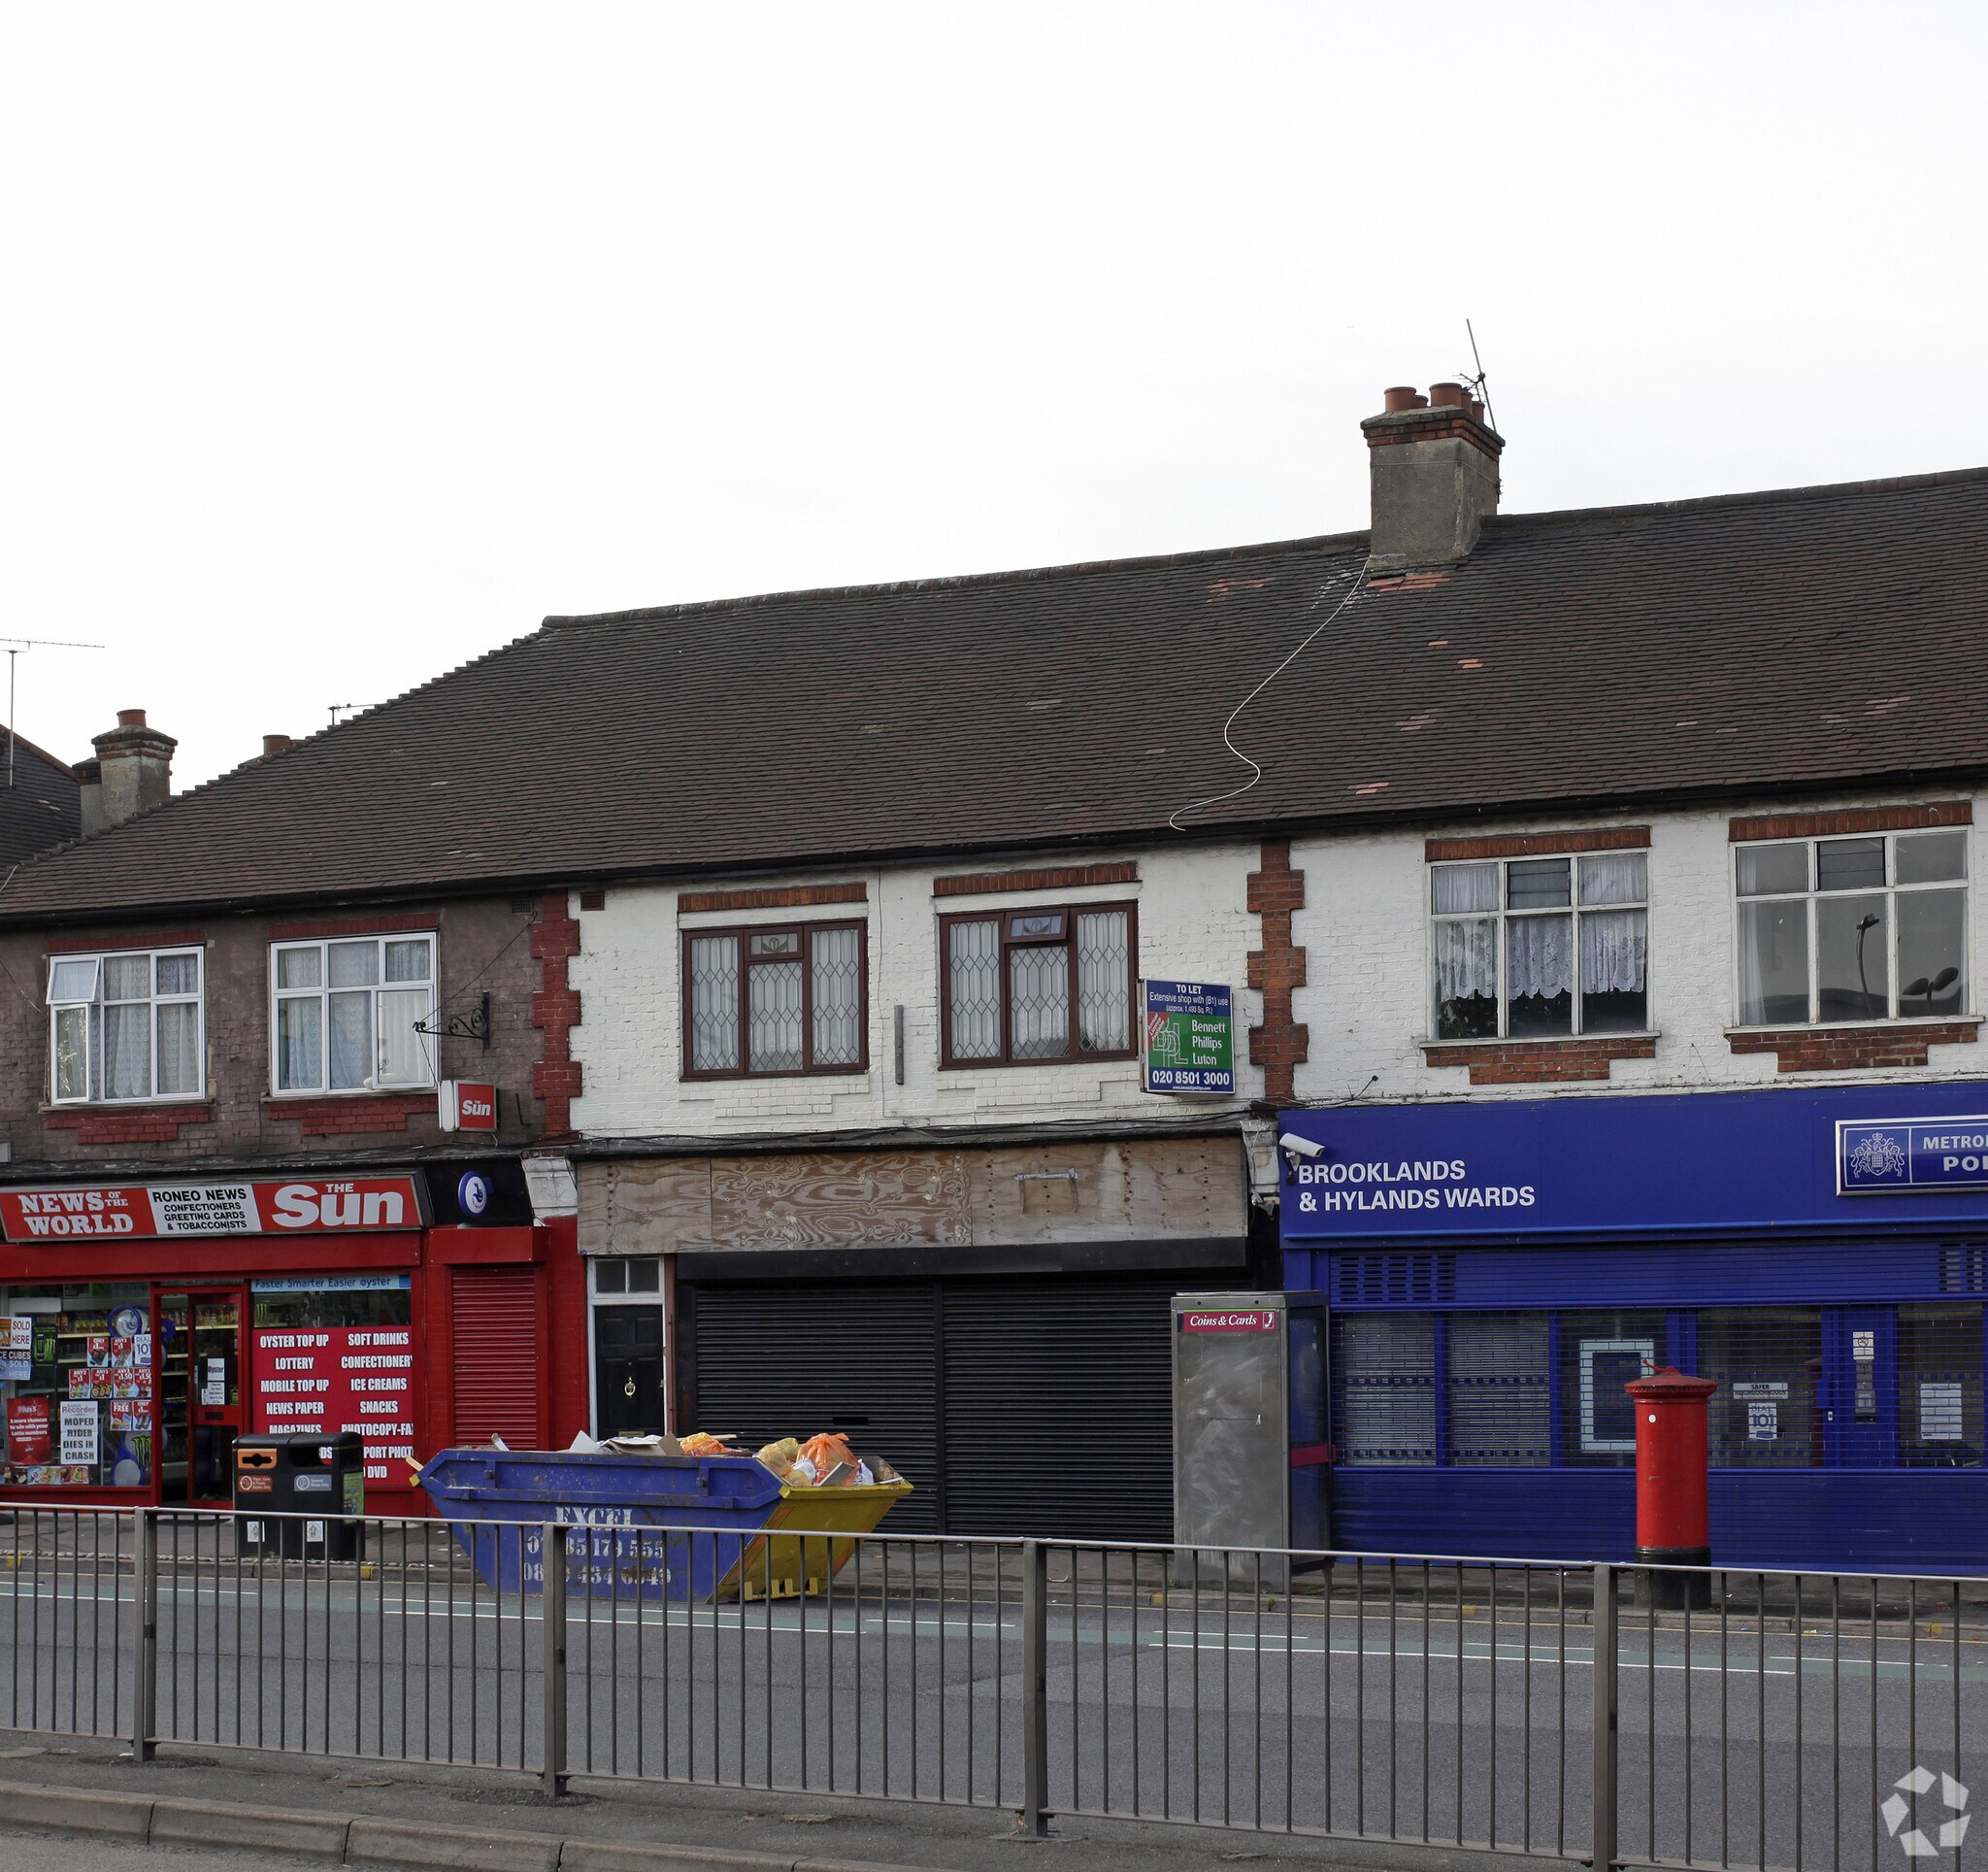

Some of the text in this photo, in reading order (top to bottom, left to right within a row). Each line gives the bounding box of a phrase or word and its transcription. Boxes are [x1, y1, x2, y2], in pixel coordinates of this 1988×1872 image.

[1176, 985, 1202, 994] TO LET
[1149, 992, 1176, 1003] Extensive
[1177, 993, 1192, 1005] shop
[1193, 995, 1204, 1004] with
[1192, 1020, 1226, 1033] Bennett
[1192, 1035, 1222, 1052] Phillips
[1193, 1053, 1216, 1065] Luton
[1152, 1070, 1230, 1086] 020 8501 3000
[462, 1099, 491, 1116] Sun
[1923, 1134, 1988, 1150] METRO
[1298, 1160, 1466, 1185] BROOKLANDS
[325, 1183, 353, 1193] THE
[152, 1187, 247, 1203] RONEO NEWS
[1299, 1186, 1536, 1212] & HYLANDS WARDS
[18, 1191, 105, 1214] NEWS
[105, 1197, 128, 1208] THE
[164, 1202, 241, 1212] CONFECTIONERS
[272, 1184, 403, 1227] Sun
[164, 1210, 246, 1221] GREETING CARDS
[23, 1212, 133, 1235] WORLD
[177, 1220, 247, 1230] TOBACCONISTS
[255, 1277, 390, 1288] Faster Smarter Easier oyster
[13, 1320, 30, 1330] SOLD
[1190, 1315, 1257, 1326] Coins & Cards
[12, 1335, 30, 1344] HERE
[260, 1334, 329, 1348] OYSTER TOP UP
[348, 1332, 409, 1347] SOFT DRINKS
[9, 1351, 31, 1359] CUBES
[276, 1357, 314, 1370] LOTTERY
[261, 1380, 329, 1392] MOBILE TOP UP
[350, 1378, 407, 1390] ICE CREAMS
[61, 1405, 95, 1414] Recorder
[266, 1401, 324, 1415] NEWS PAPER
[360, 1401, 398, 1414] SNACKS
[64, 1418, 94, 1426] MOPED
[1752, 1414, 1773, 1427] 101
[269, 1424, 322, 1433] MAGAZINES
[63, 1440, 93, 1449] DIES IN
[65, 1452, 95, 1460] CRASH
[388, 1446, 414, 1458] PHOT
[367, 1465, 387, 1479] DVD
